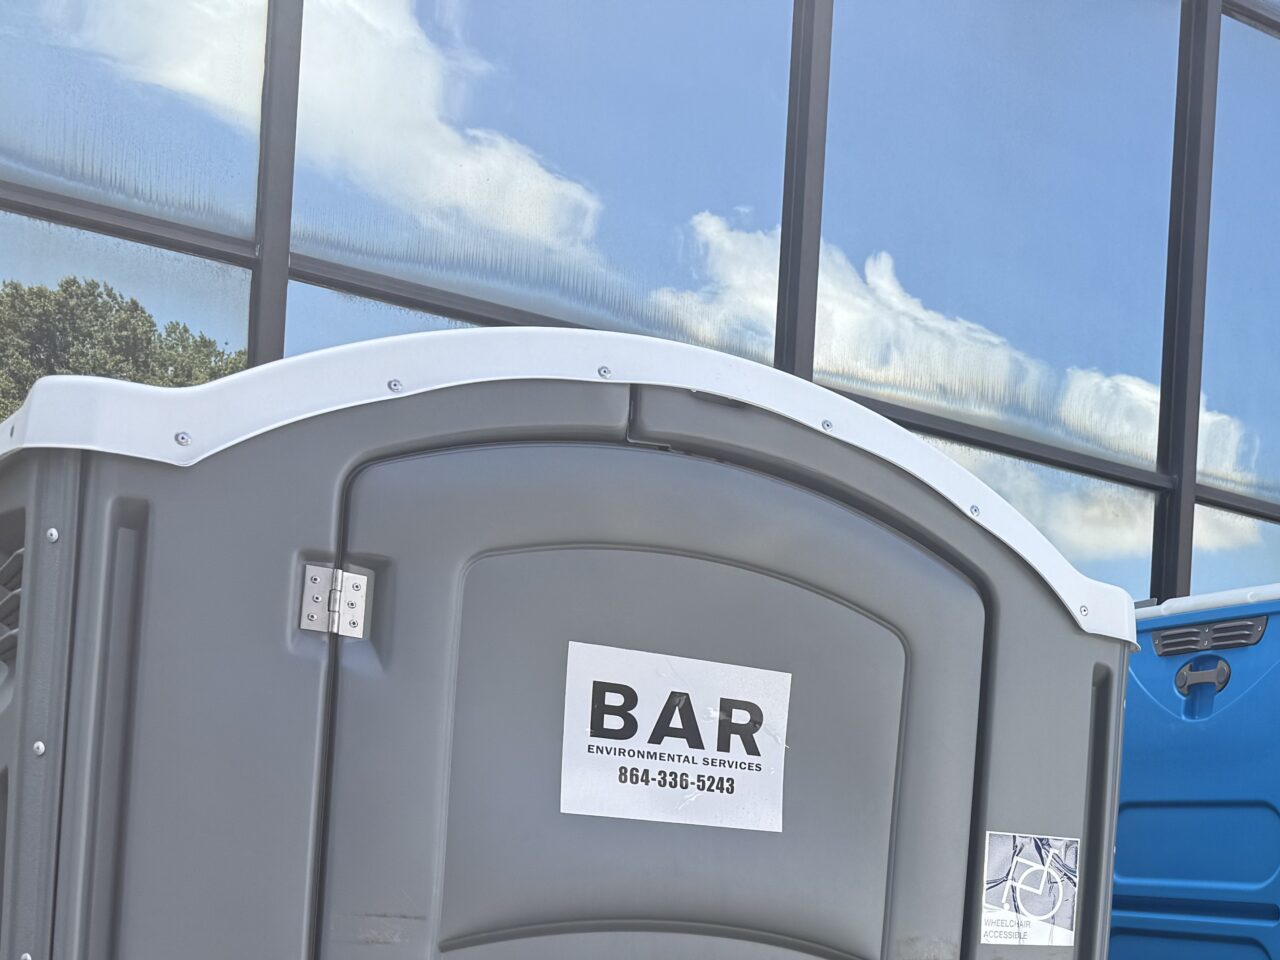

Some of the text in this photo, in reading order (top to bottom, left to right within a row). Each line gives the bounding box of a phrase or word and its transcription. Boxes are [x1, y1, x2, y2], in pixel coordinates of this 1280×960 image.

[589, 680, 764, 757] BAR
[587, 744, 762, 772] ENVIRONMENTAL SERVICES
[618, 766, 735, 795] 864-336-5243
[983, 931, 1028, 940] ACCESSIBLE
[984, 919, 1031, 928] WHEELCHAIR
